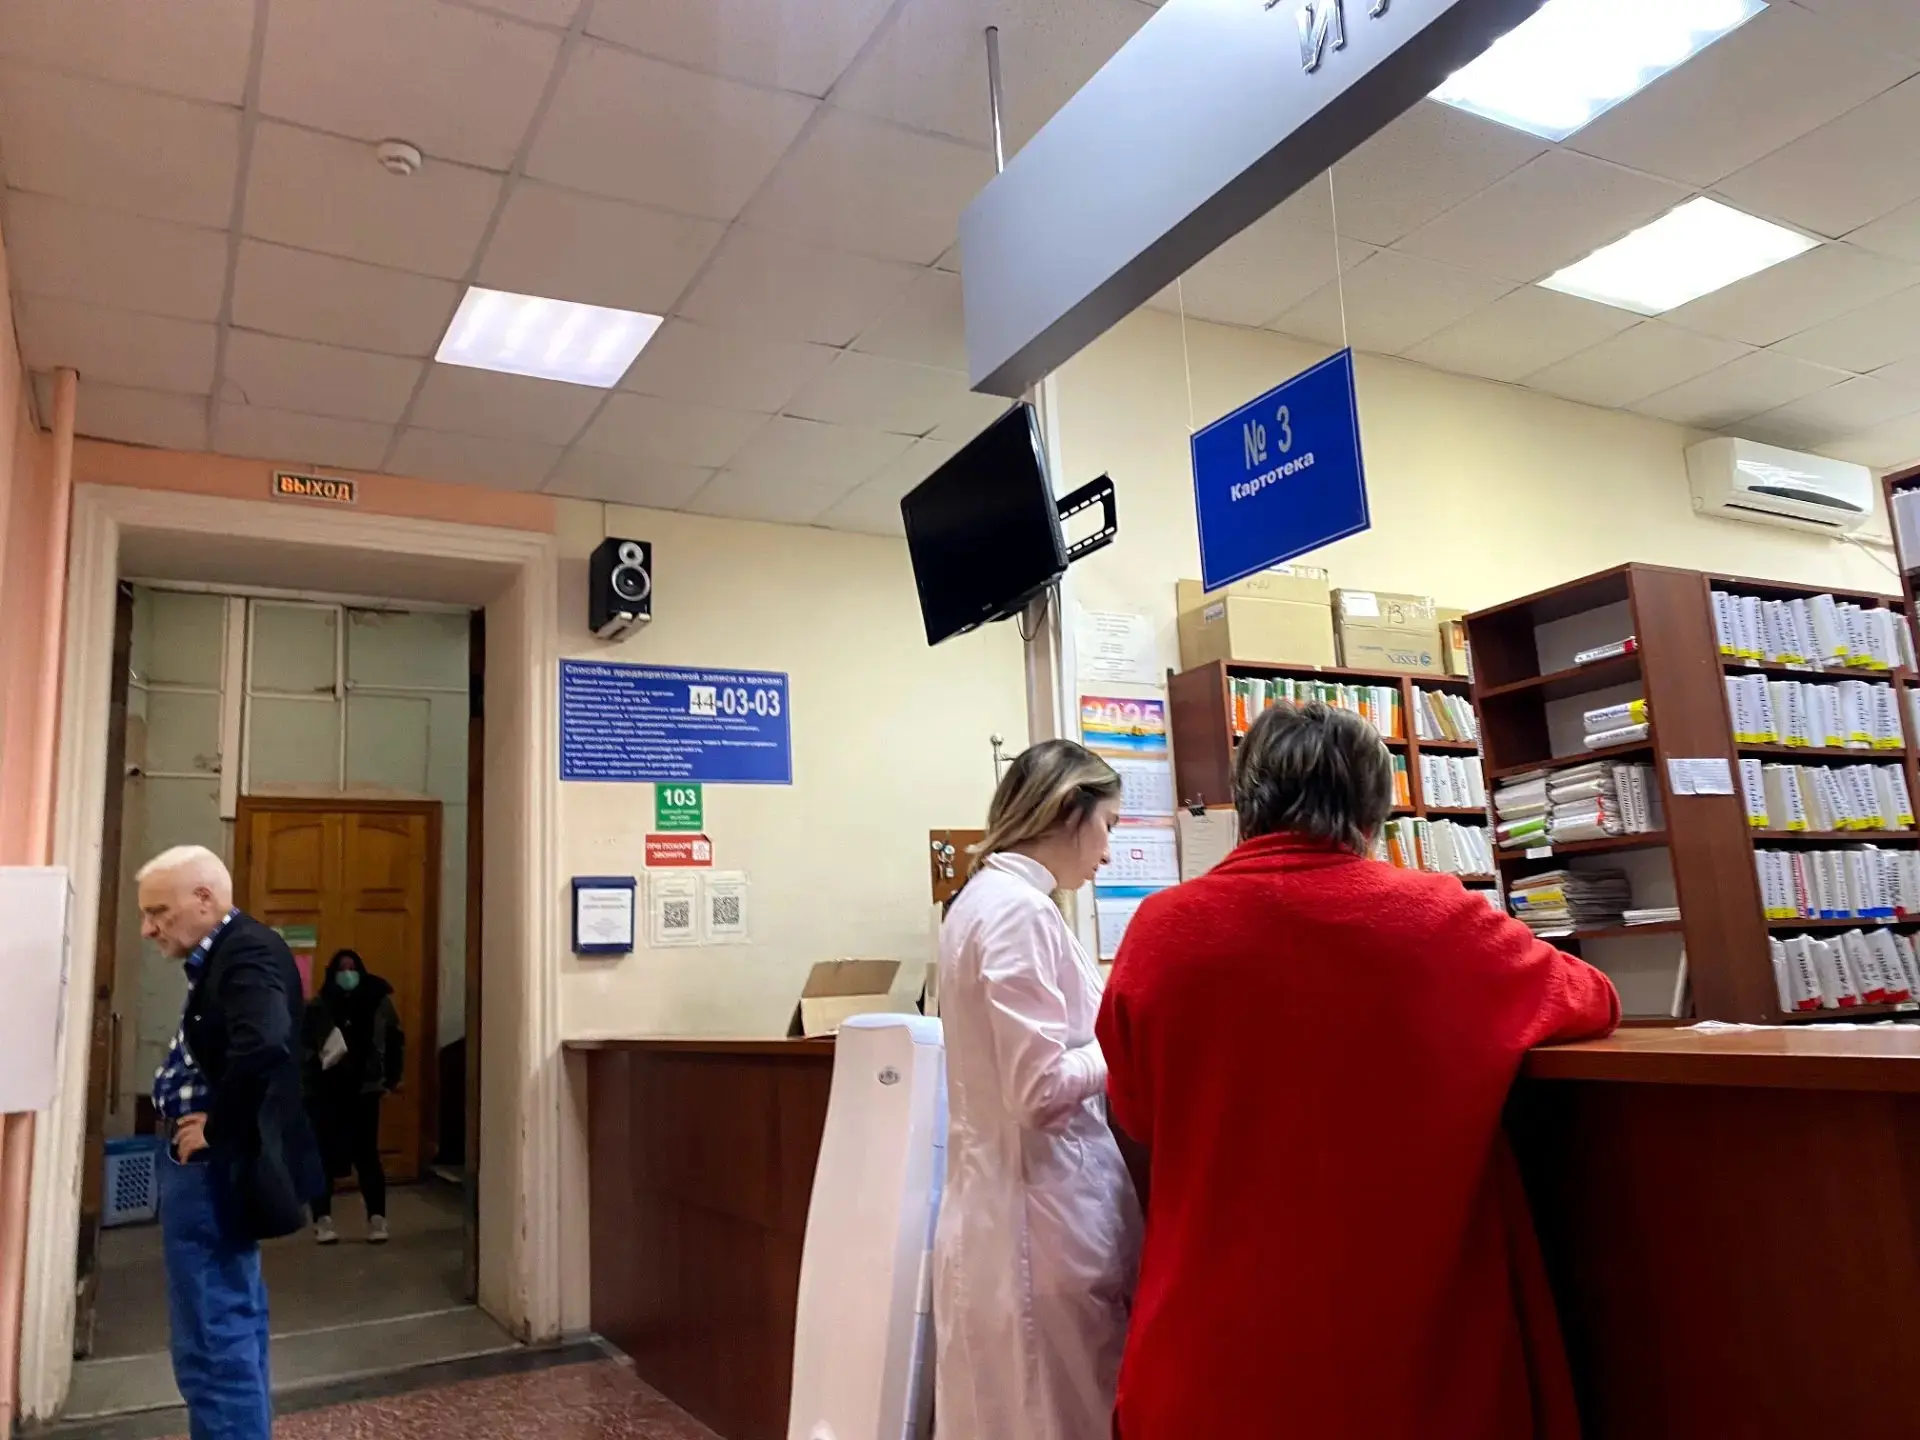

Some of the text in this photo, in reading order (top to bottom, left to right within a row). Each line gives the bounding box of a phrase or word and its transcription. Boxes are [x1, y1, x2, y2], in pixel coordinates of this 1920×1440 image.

[1243, 404, 1293, 470] № 3
[280, 476, 351, 501] ВЫХОД
[1230, 451, 1315, 502] Картотека
[565, 664, 612, 676] Способы
[702, 673, 738, 684] записи
[663, 789, 697, 806] 103
